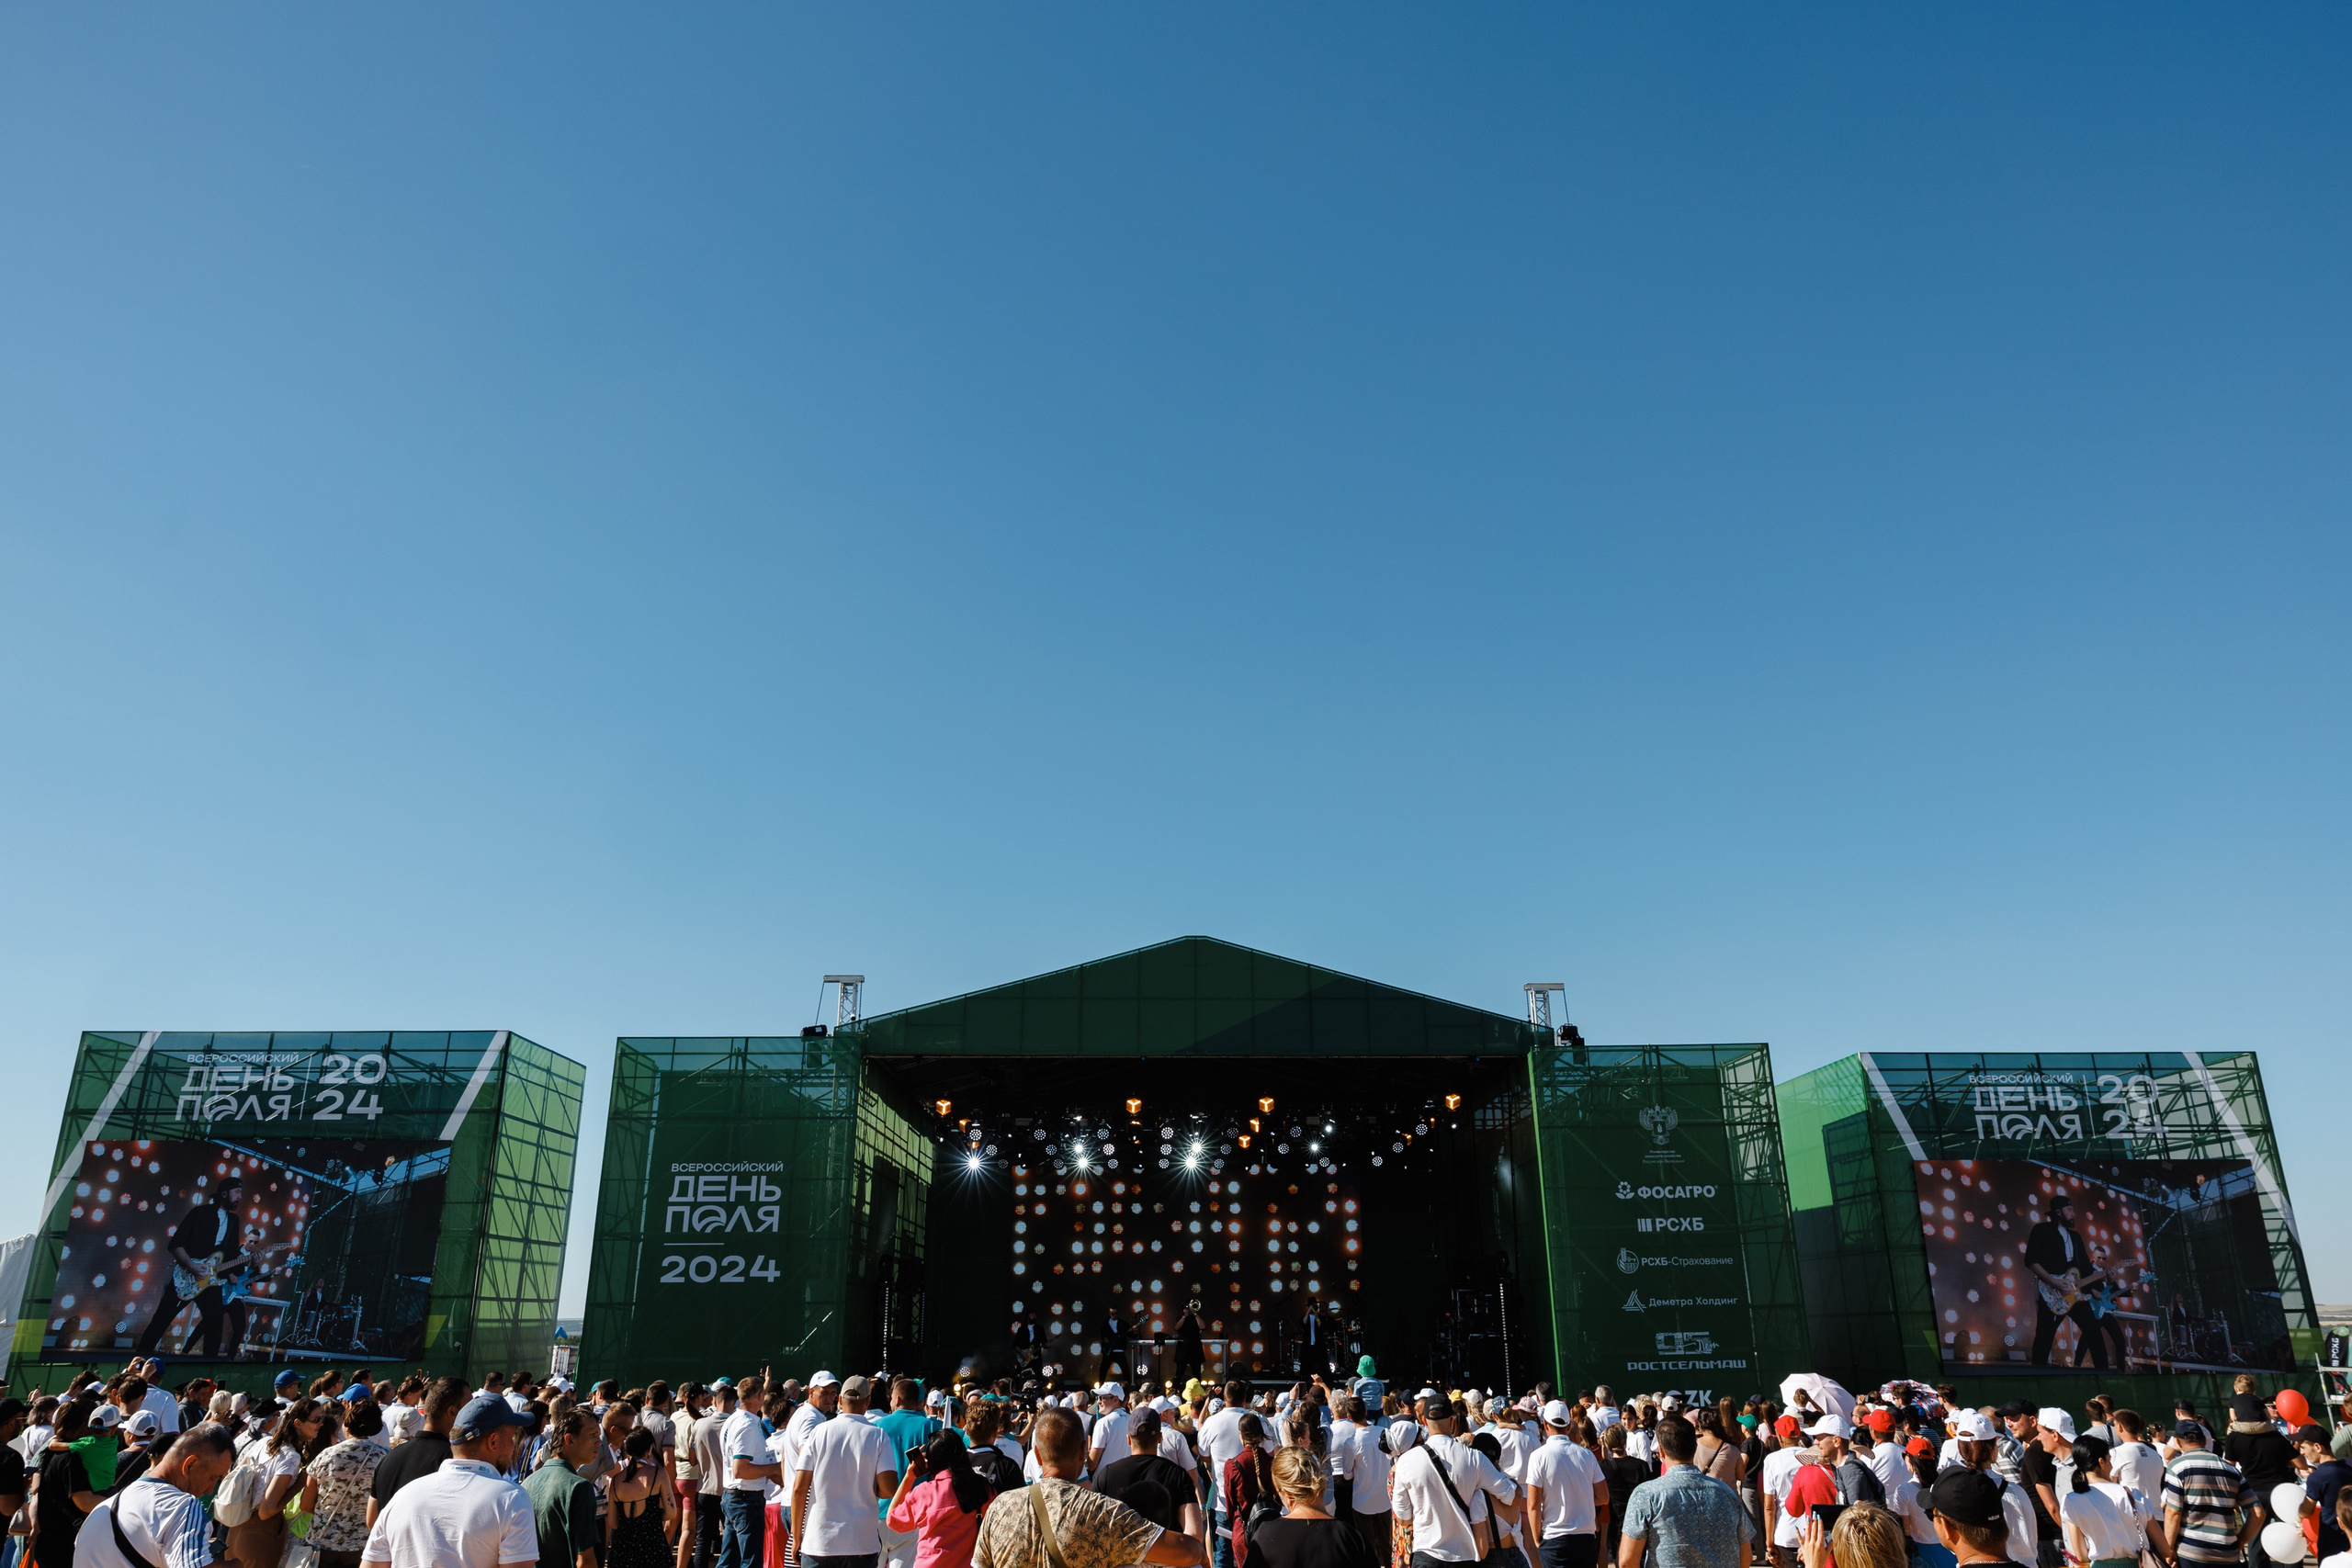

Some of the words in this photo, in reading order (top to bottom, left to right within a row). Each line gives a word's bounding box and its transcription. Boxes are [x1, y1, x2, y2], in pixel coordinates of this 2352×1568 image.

[187, 1052, 300, 1063] ВСЕРОССИЙСКИЙ
[319, 1054, 387, 1085] 20
[181, 1066, 295, 1092] ДЕНЬ
[1968, 1072, 2074, 1084] ВСЕРОССИЙСКИЙ
[2097, 1075, 2158, 1104] 20
[175, 1094, 292, 1122] ПОЛЯ
[312, 1089, 384, 1121] 24
[1973, 1086, 2078, 1111] ДЕНЬ
[1975, 1113, 2084, 1140] ПОЛЯ
[2102, 1109, 2169, 1139] 24
[671, 1160, 784, 1172] ВСЕРОССИЙСКИЙ
[668, 1175, 782, 1202] ДЕНЬ
[1637, 1185, 1715, 1200] ФОСАГРО
[664, 1204, 780, 1234] ПОЛЯ
[1655, 1217, 1704, 1232] РСХБ
[660, 1255, 781, 1283] 2024
[1641, 1256, 1734, 1268] РСХБ-Страхование
[1648, 1298, 1693, 1307] Деметра
[1695, 1296, 1738, 1305] Холдинг
[1627, 1359, 1747, 1371] РОСТСЕЛЬМАШ
